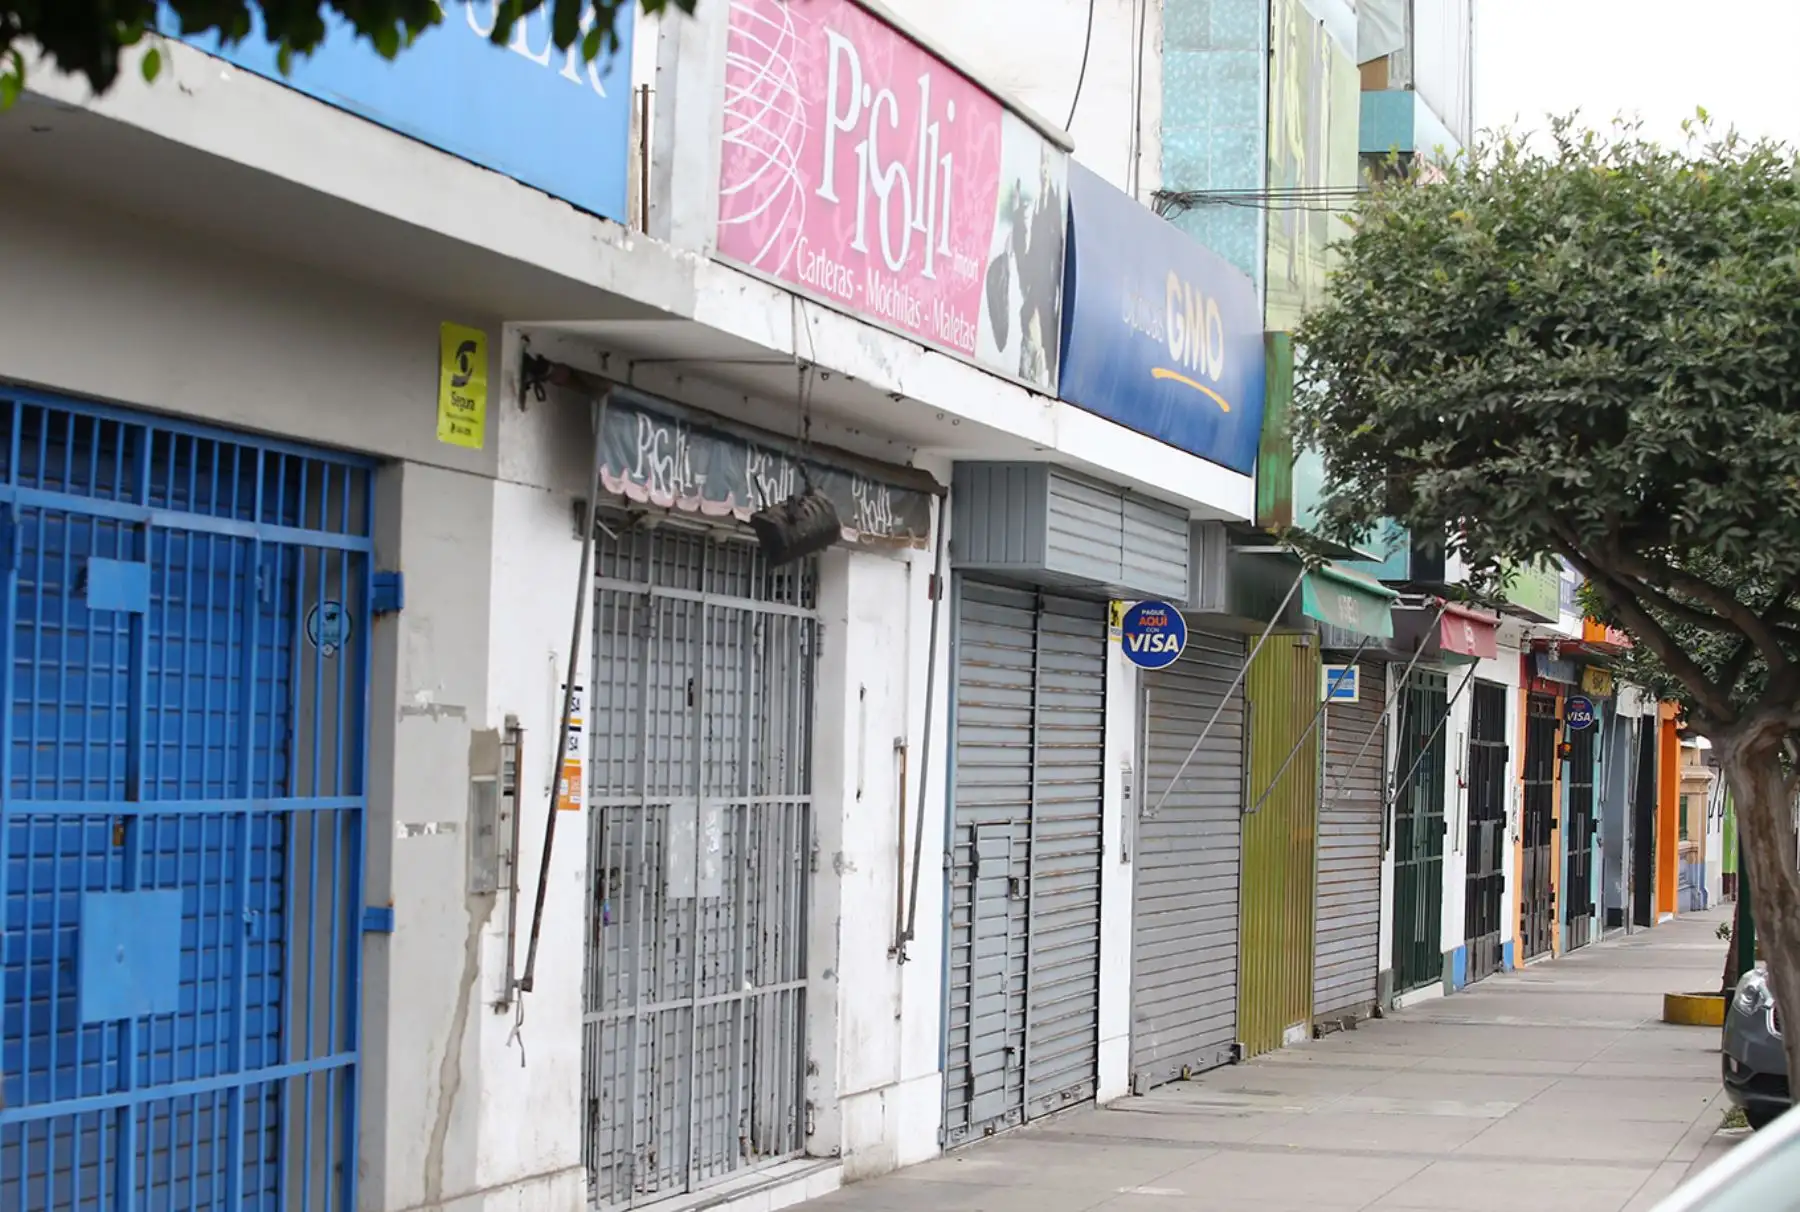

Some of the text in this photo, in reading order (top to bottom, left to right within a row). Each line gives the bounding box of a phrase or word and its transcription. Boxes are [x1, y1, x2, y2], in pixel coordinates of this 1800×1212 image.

[796, 236, 854, 300] Carteras
[865, 266, 921, 329] Mochilas
[932, 297, 977, 351] Maletas
[1166, 268, 1224, 382] GMO
[1126, 633, 1180, 653] VISA
[1566, 711, 1592, 722] VISA
